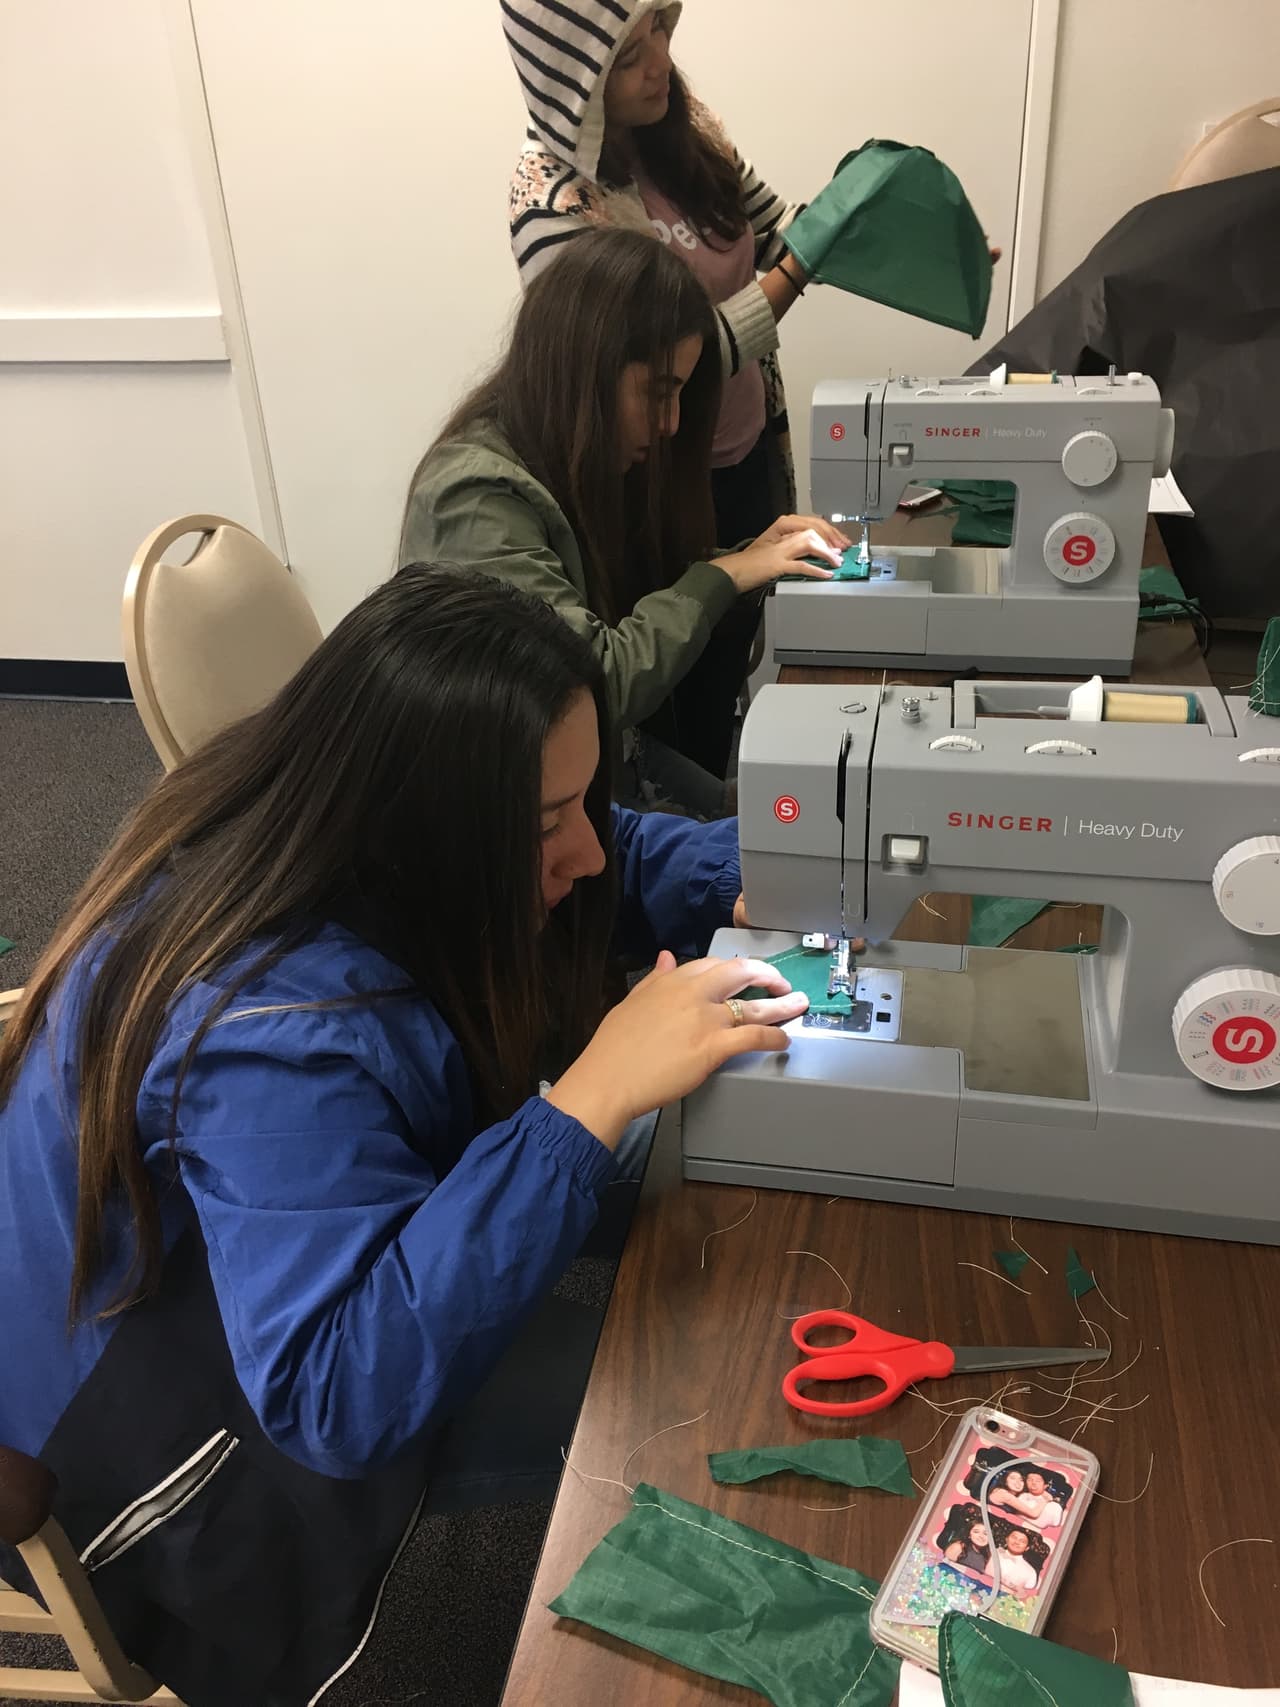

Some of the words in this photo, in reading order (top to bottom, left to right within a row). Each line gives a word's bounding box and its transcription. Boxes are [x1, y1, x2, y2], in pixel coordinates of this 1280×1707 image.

[925, 427, 981, 437] SINGER
[993, 427, 1022, 439] Heavy
[1024, 426, 1048, 439] Duty
[1070, 541, 1088, 560] S
[947, 812, 1053, 833] SINGER
[1079, 819, 1136, 840] Heavy
[1140, 822, 1184, 842] Duty
[1225, 1028, 1264, 1054] S
